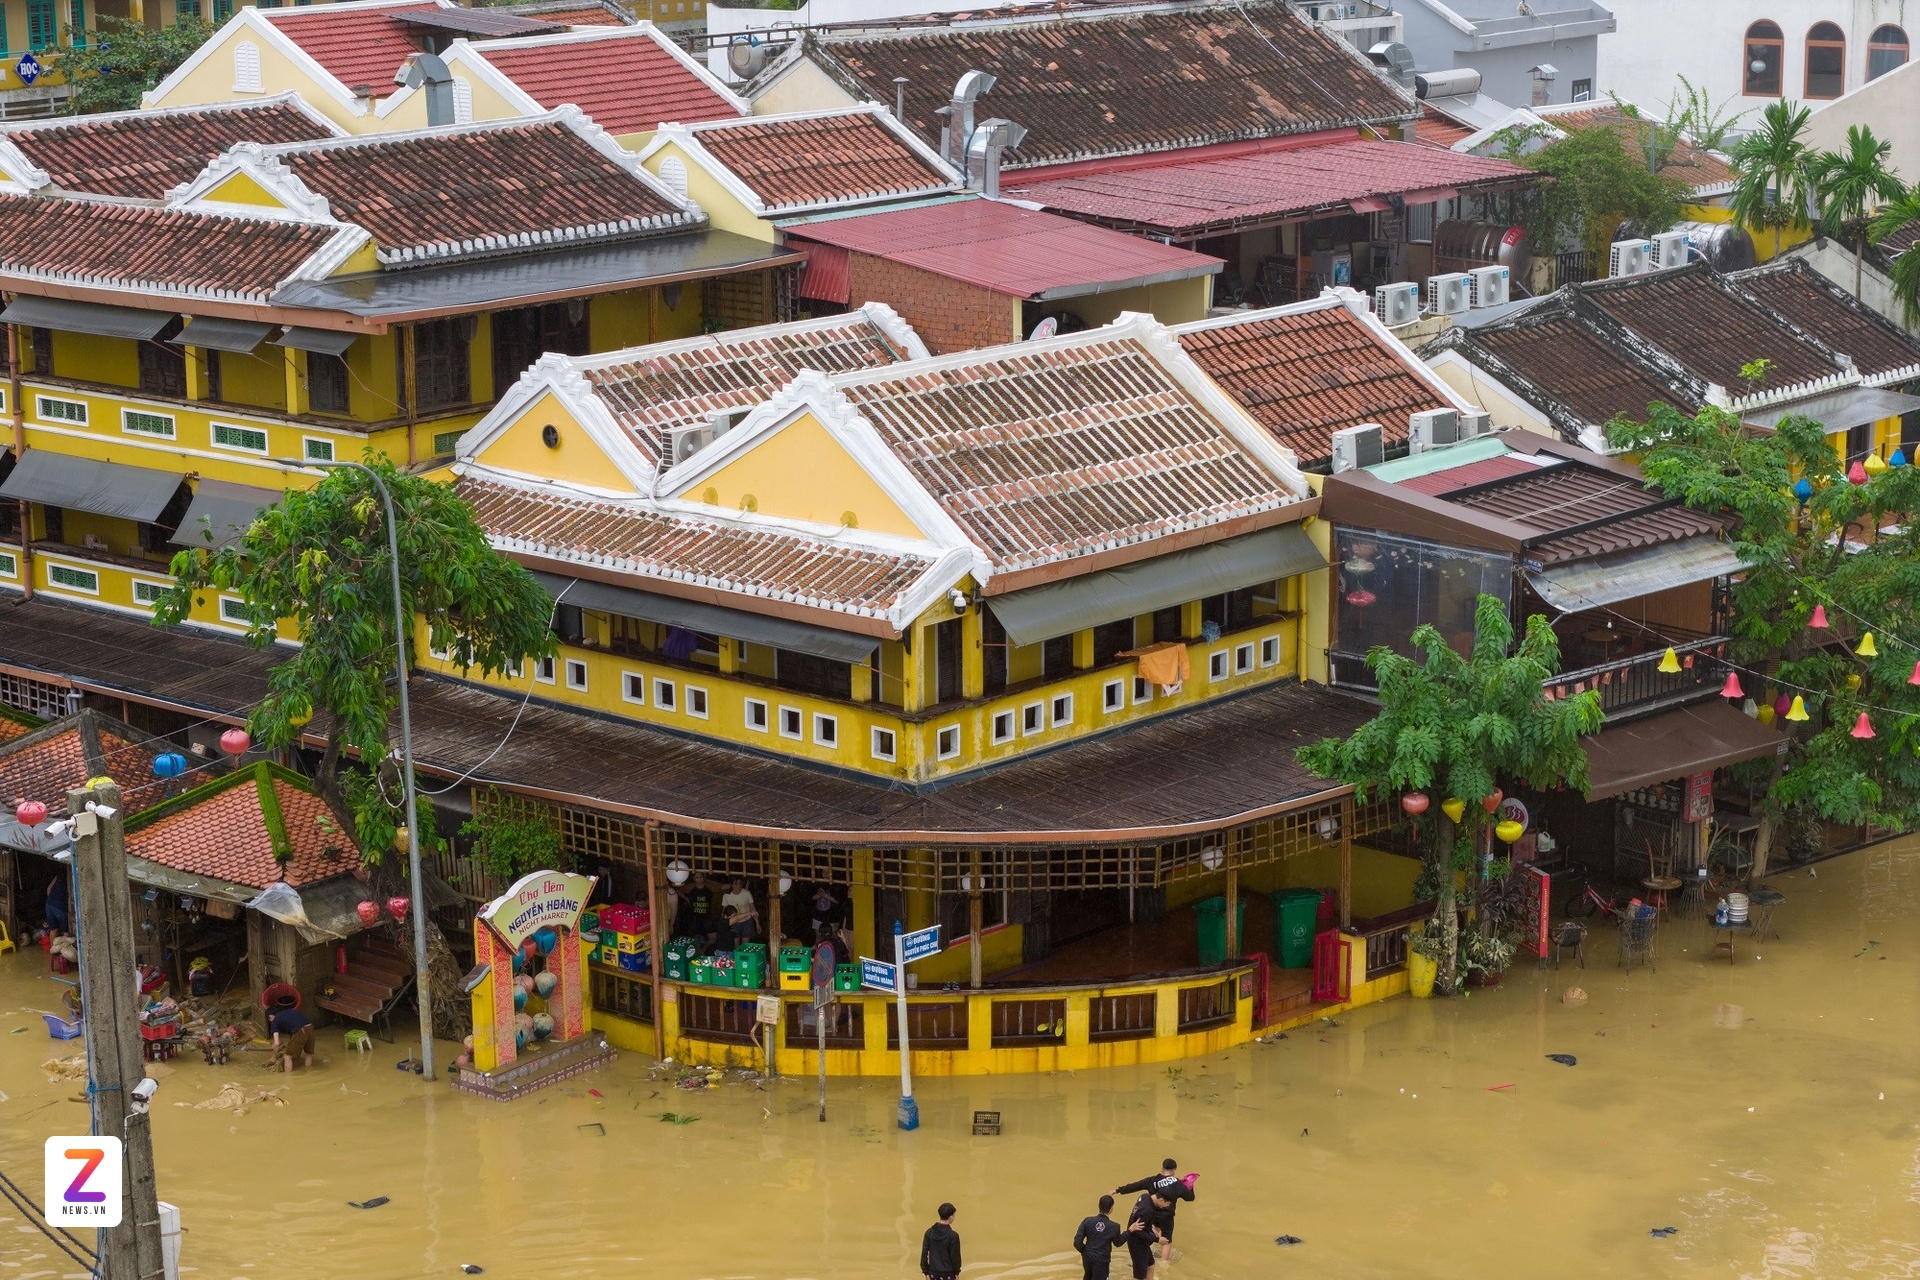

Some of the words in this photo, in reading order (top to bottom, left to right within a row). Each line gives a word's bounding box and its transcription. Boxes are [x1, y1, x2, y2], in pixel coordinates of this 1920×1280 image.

[20, 62, 38, 78] HỌC
[519, 888, 539, 906] Chợ
[543, 880, 565, 894] Đêm
[546, 897, 579, 912] HOÀNG
[519, 919, 540, 935] NIGHT
[541, 912, 569, 922] MARKET
